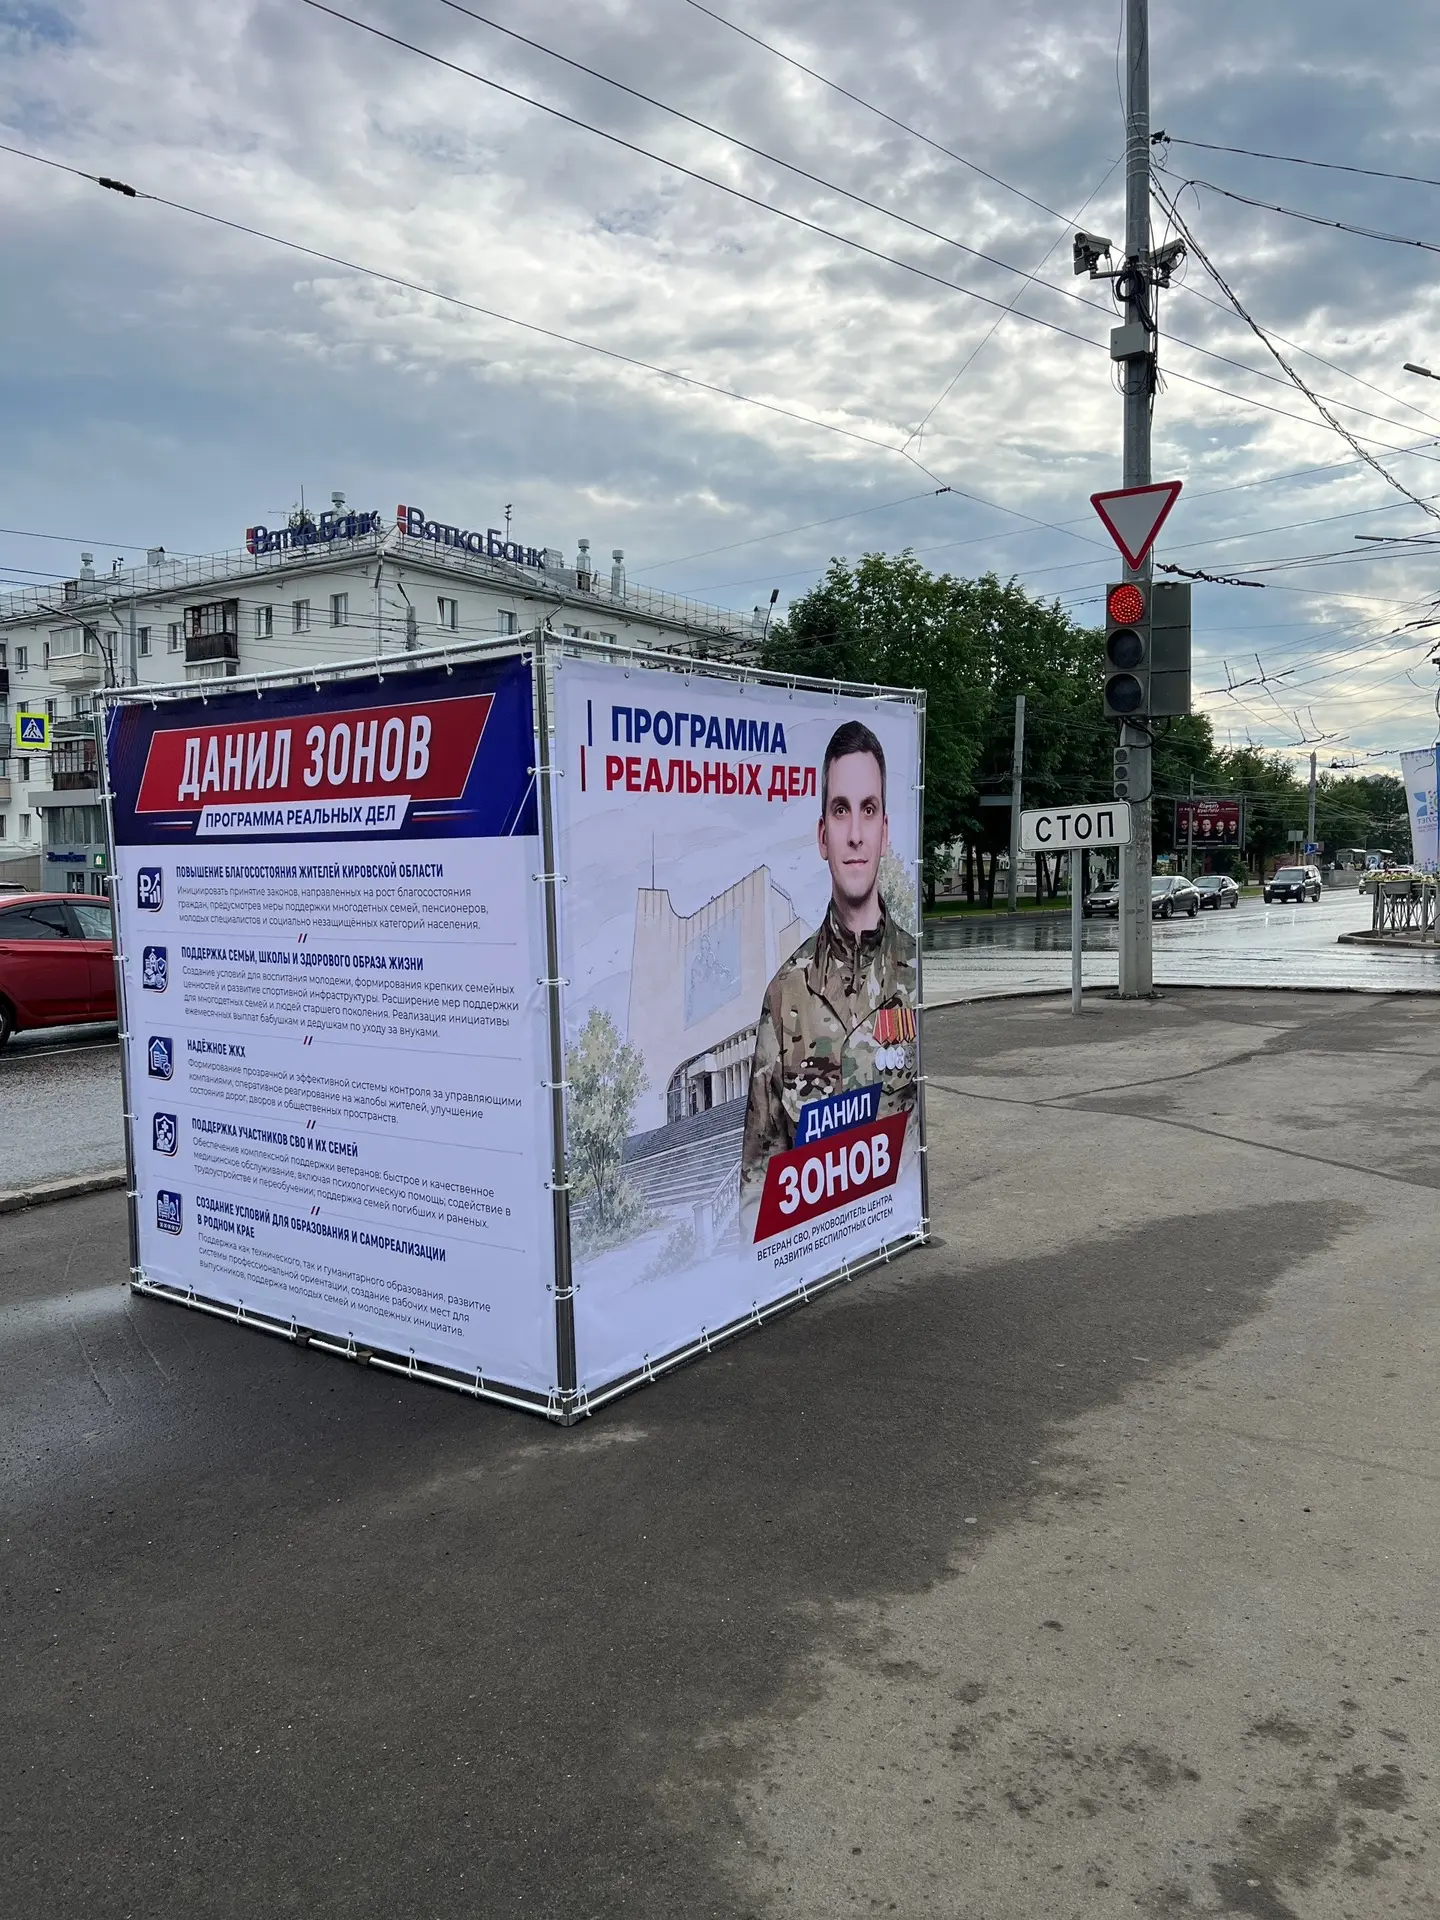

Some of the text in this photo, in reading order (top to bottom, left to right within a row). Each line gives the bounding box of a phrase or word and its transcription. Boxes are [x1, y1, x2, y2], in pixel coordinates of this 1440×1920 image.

[612, 705, 787, 754] ПРОГРАММА
[177, 714, 432, 801] ДАНИЛ ЗОНОВ
[606, 755, 816, 802] РЕАЛЬНЫХ ДЕЛ
[205, 804, 396, 828] ПРОГРАММА РЕАЛЬНЫХ ДЕЛ
[1035, 811, 1114, 842] СТОП
[175, 863, 443, 879] ПОВЫШЕНИЕ БЛАГОСОСТОЯНИЯ ЖИТЕЛЕЙ КИРОВСКОЙ ОБЛАСТИ
[262, 902, 284, 912] меры
[285, 903, 331, 913] поддержки
[332, 900, 389, 914] многодетных
[300, 888, 362, 898] направленных
[362, 888, 375, 899] на
[374, 888, 396, 899] рост
[397, 886, 471, 900] благосостояния
[268, 917, 312, 926] социально
[310, 914, 378, 928] незащищённых
[379, 918, 425, 930] категорий
[181, 946, 424, 971] ПОДДЕРЖКА СЕМЬИ, ШКОЛЫ И ЗДОРОВОГО ОБРАЗА ЖИЗНИ
[261, 987, 308, 998] спортивной
[381, 992, 441, 1008] Расширение
[439, 998, 461, 1010] мер
[462, 999, 519, 1013] поддержки
[262, 972, 308, 983] воспитания
[354, 976, 423, 992] формирования
[422, 982, 464, 993] крепких
[464, 984, 515, 997] семейных
[259, 1012, 299, 1026] бабушкам
[306, 1019, 349, 1030] дедушкам
[349, 1022, 361, 1032] по
[361, 1023, 386, 1035] уходу
[387, 1025, 398, 1034] за
[274, 1000, 302, 1012] людей
[302, 1004, 341, 1015] старшего
[391, 1008, 446, 1023] Реализация
[448, 1011, 509, 1027] инициативы
[186, 1039, 246, 1058] НАДЁЖНОЕ ЖКХ
[283, 1086, 341, 1102] реагирование
[341, 1094, 352, 1103] на
[353, 1095, 388, 1108] жалобы
[430, 1104, 484, 1119] улучшение
[295, 1073, 350, 1088] эффективной
[351, 1080, 388, 1093] системы
[389, 1085, 432, 1099] контроля
[432, 1089, 444, 1099] за
[444, 1091, 522, 1107] управляющими
[283, 1099, 342, 1116] общественных
[805, 1093, 871, 1143] ДАНИЛ
[191, 1117, 358, 1157] ПОДДЕРЖКА УЧАСТНИКОВ СВО И ИХ СЕМЕЙ
[290, 1156, 335, 1172] поддержки
[382, 1170, 421, 1187] быстрое
[429, 1180, 494, 1199] качественное
[778, 1133, 891, 1215] ЗОНОВ
[297, 1171, 331, 1185] включая
[332, 1178, 407, 1200] психологическую
[447, 1198, 503, 1215] содействие
[316, 1189, 362, 1205] поддержка
[362, 1196, 391, 1211] семей
[390, 1201, 437, 1219] погибших
[195, 1195, 446, 1262] СОЗДАНИЕ УСЛОВИЙ ДЛЯ ОБРАЗОВАНИЯ И САМОРЕАЛИЗАЦИИ
[197, 1213, 255, 1238] В РОДНОМ КРАЕ
[757, 1194, 893, 1262] ВЕТЕРАН СВО, РУКОВОДИТЕЛЬ ЦЕНТРА
[774, 1207, 893, 1269] РАЗВИТИЯ БЕСПИЛОТНЫХ СИСТЕМ
[302, 1260, 316, 1271] так
[323, 1265, 385, 1287] гуманитарного
[447, 1295, 491, 1312] развитие
[288, 1284, 323, 1300] молодых
[323, 1293, 349, 1307] семей
[356, 1300, 413, 1324] молодежных
[350, 1286, 390, 1304] создание
[391, 1295, 429, 1313] рабочих
[429, 1305, 451, 1319] мест
[452, 1311, 470, 1322] для
